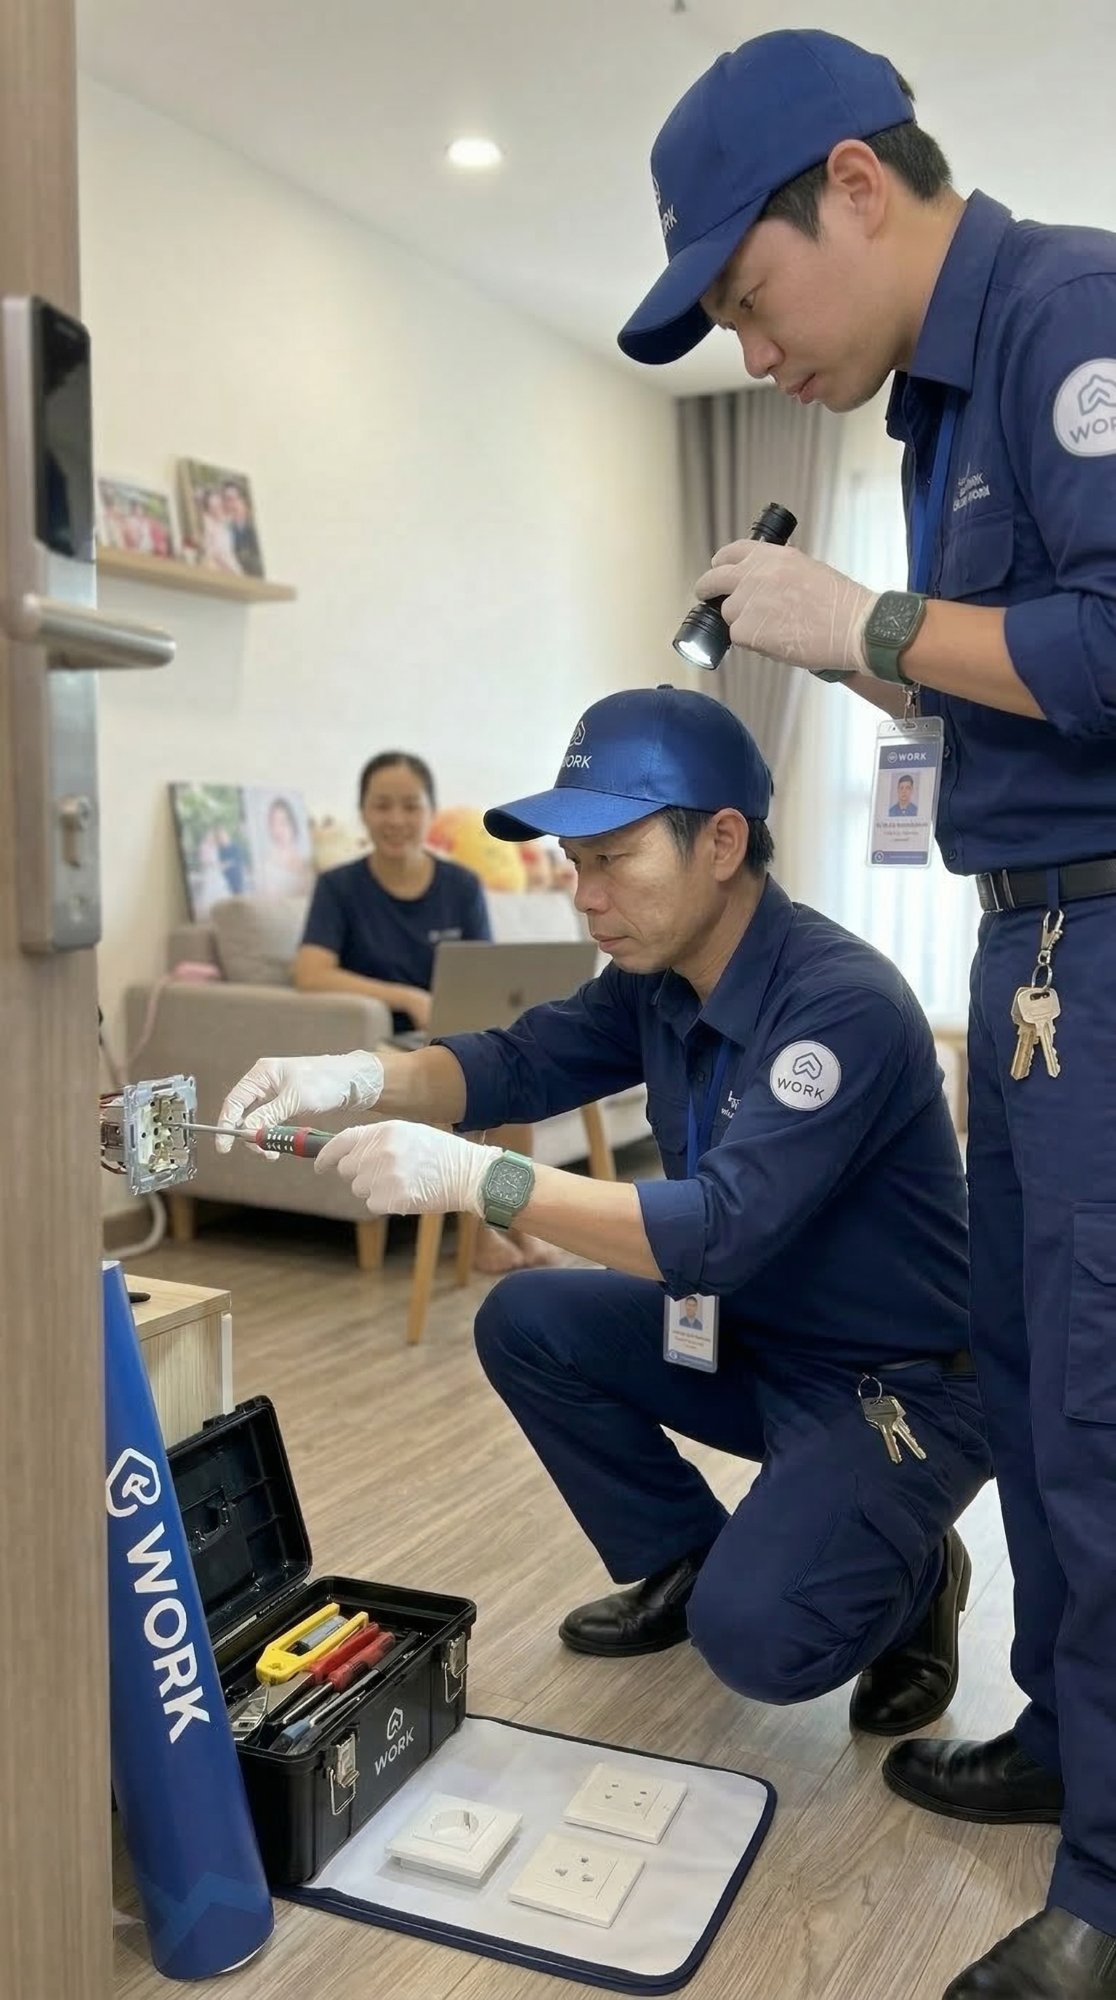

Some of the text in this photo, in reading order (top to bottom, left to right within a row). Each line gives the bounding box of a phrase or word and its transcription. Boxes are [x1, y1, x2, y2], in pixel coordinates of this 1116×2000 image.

[562, 755, 593, 769] ORK
[899, 752, 927, 762] WORK
[777, 1077, 825, 1101] WORK
[127, 1521, 211, 1744] WORK
[374, 1726, 415, 1776] WORK
